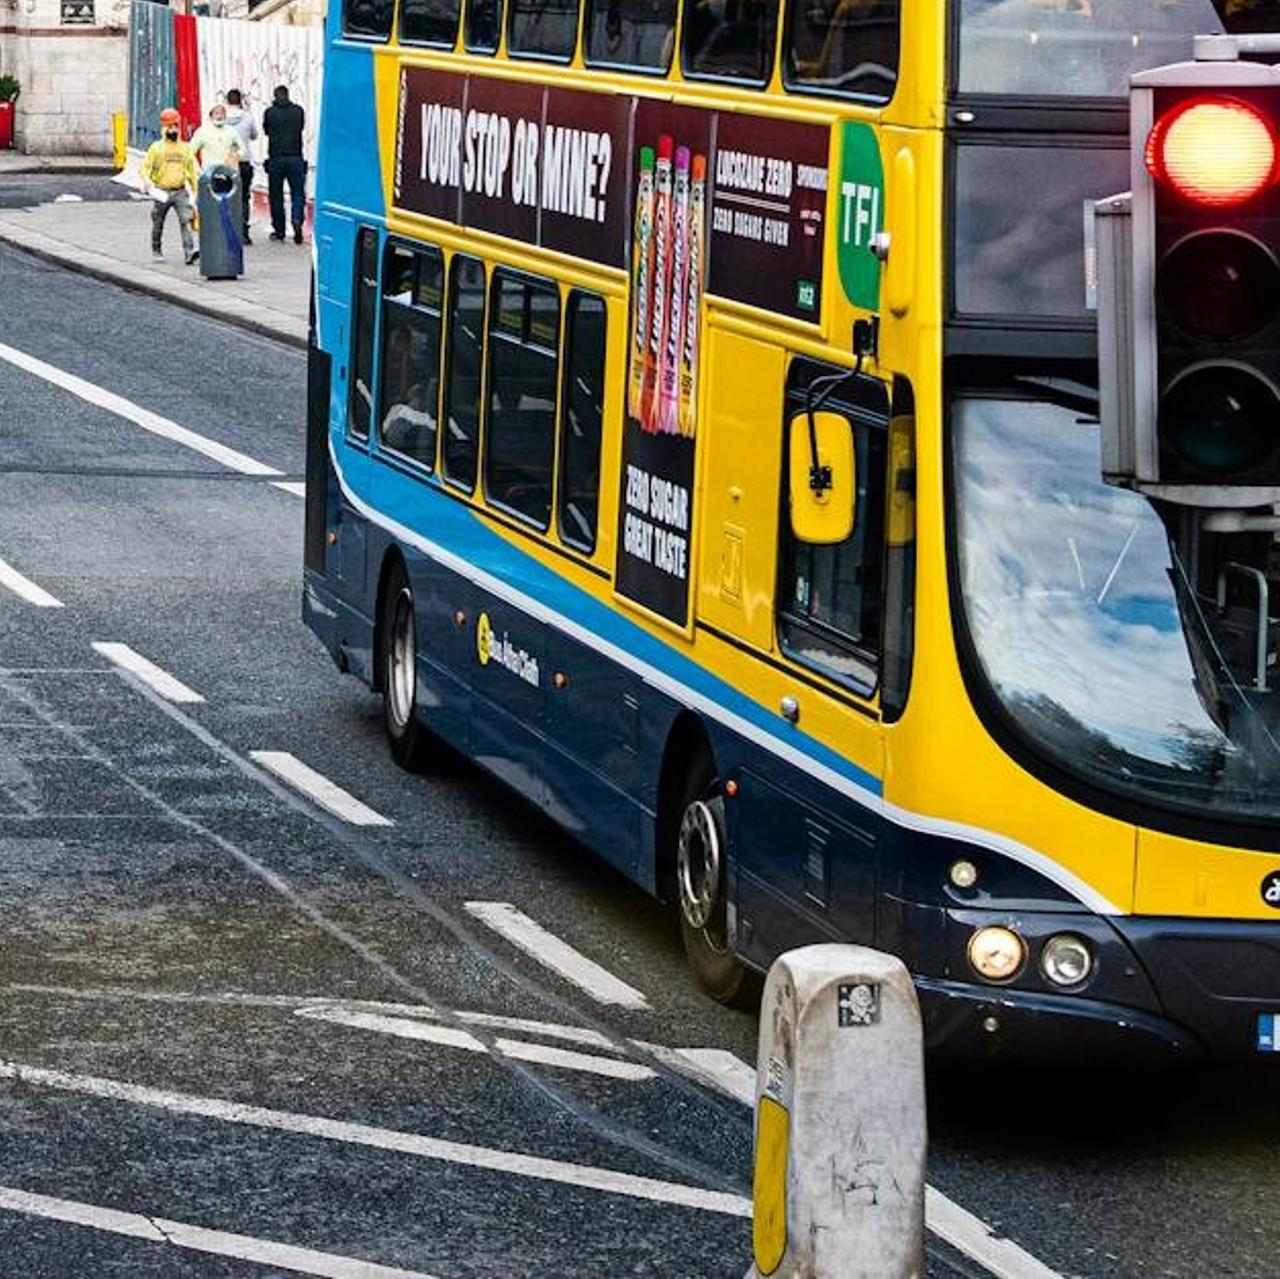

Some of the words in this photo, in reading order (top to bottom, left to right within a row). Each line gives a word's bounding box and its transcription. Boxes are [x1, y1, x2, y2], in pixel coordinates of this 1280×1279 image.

[420, 103, 462, 187] YOUR
[463, 108, 511, 199] STOP
[511, 117, 539, 208] OR
[542, 124, 612, 223] MINE?
[716, 149, 765, 194] LUCOZADE
[765, 157, 793, 198] ZERO
[713, 206, 734, 234] ZERO
[842, 181, 880, 247] TFI
[626, 463, 650, 515] ZERO
[650, 475, 689, 532] SUGAR
[624, 511, 654, 563] GREAT
[654, 525, 687, 579] TASTE
